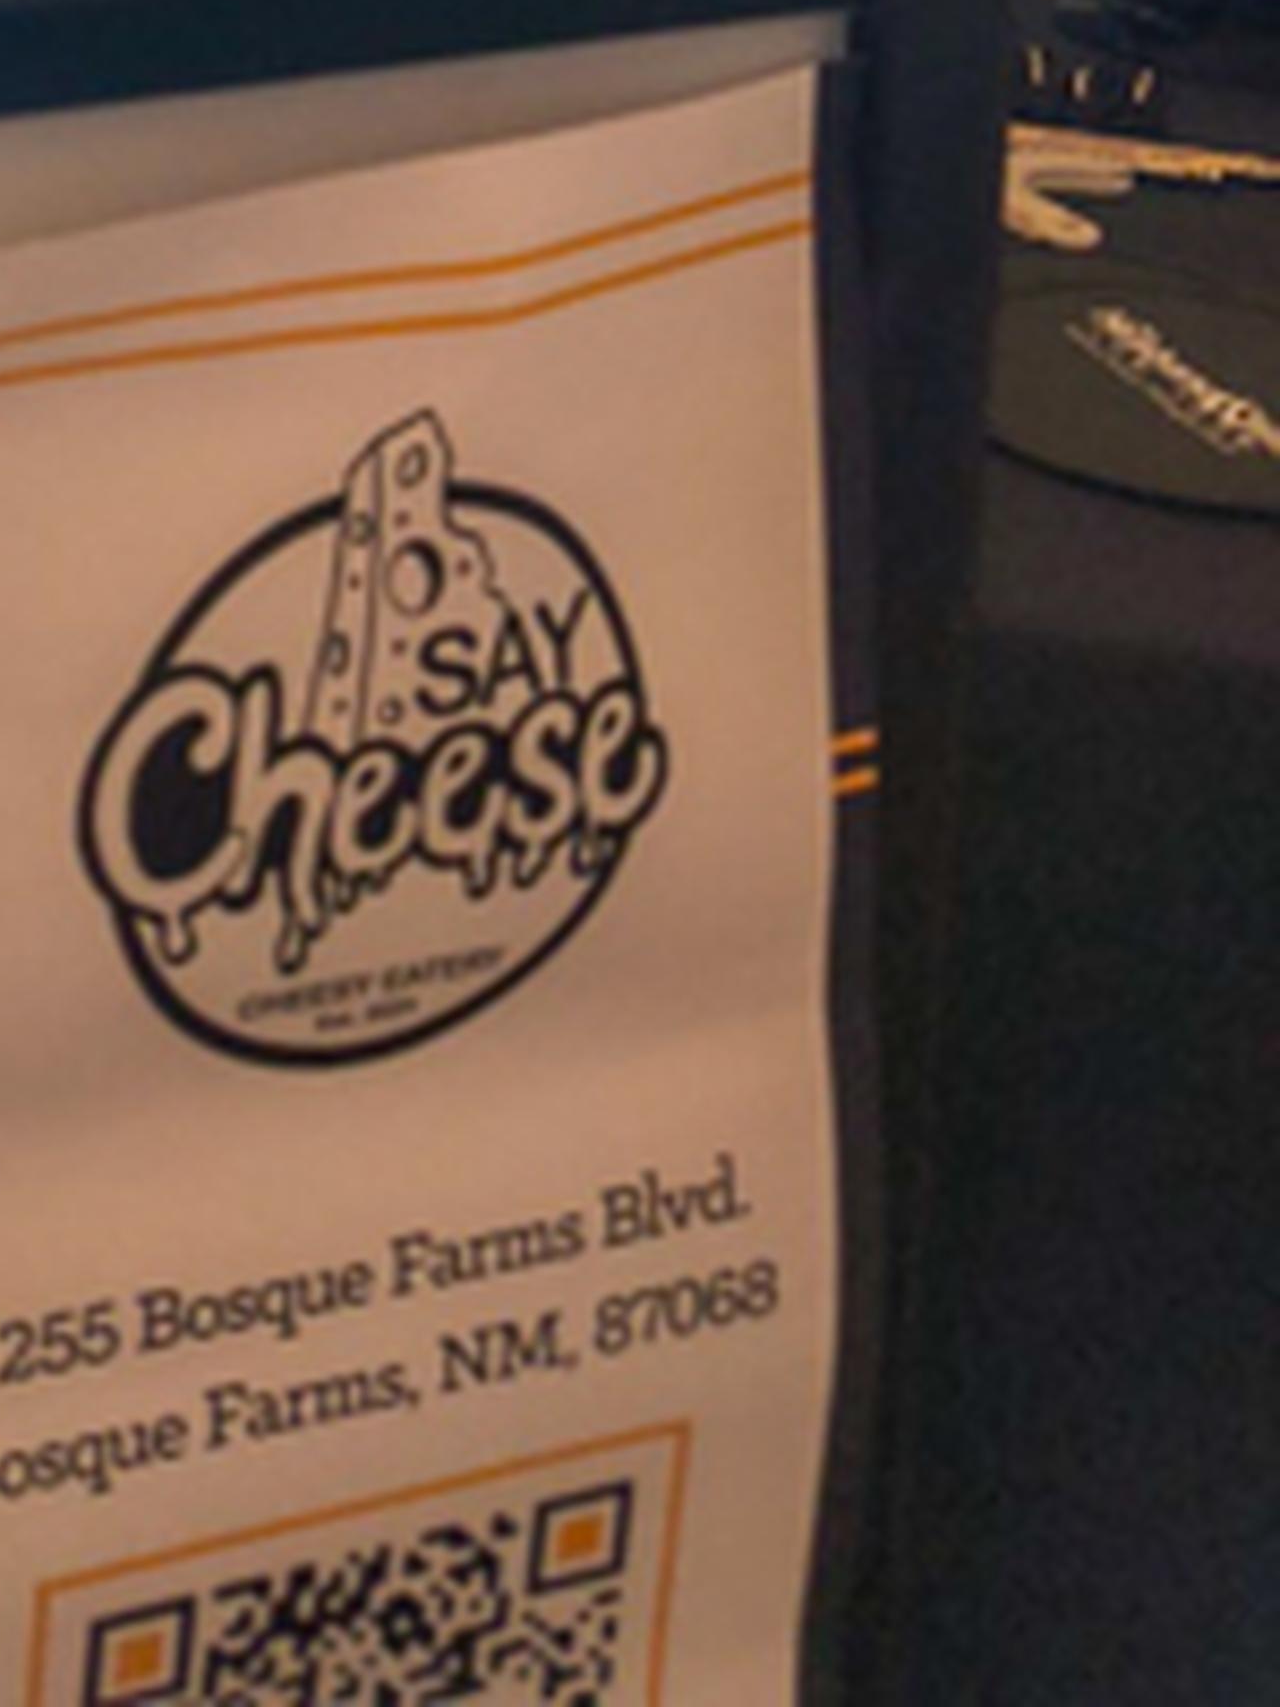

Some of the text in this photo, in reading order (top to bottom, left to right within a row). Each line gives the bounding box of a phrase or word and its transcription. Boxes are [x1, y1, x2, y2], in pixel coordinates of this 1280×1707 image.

[414, 588, 590, 715] SAY
[77, 660, 670, 917] Cheese
[136, 1260, 376, 1353] Bosque
[388, 1209, 587, 1298] Farms
[600, 1151, 752, 1250] Blvd.
[203, 1361, 421, 1451] Farms,
[438, 1309, 580, 1394] NM,
[592, 1259, 782, 1356] 87068
